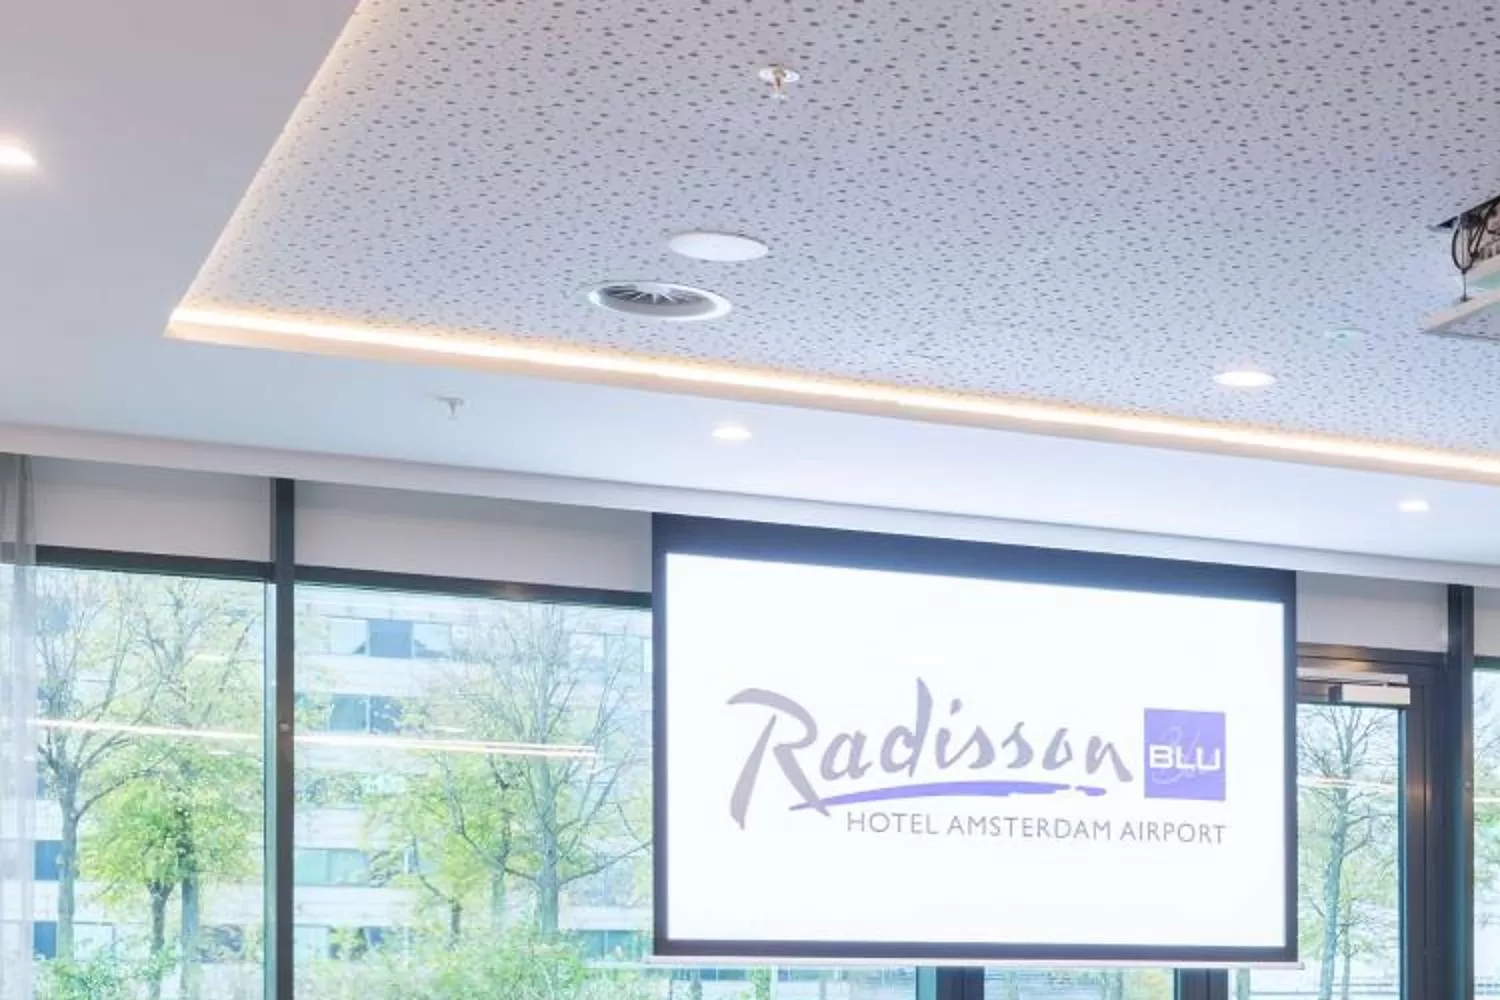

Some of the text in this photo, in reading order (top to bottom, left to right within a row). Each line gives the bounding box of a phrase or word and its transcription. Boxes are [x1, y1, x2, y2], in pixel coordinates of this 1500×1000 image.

[726, 677, 1222, 830] Radisson BLU
[847, 811, 1227, 845] HOTEL AMSTERDAM AIRPORT
